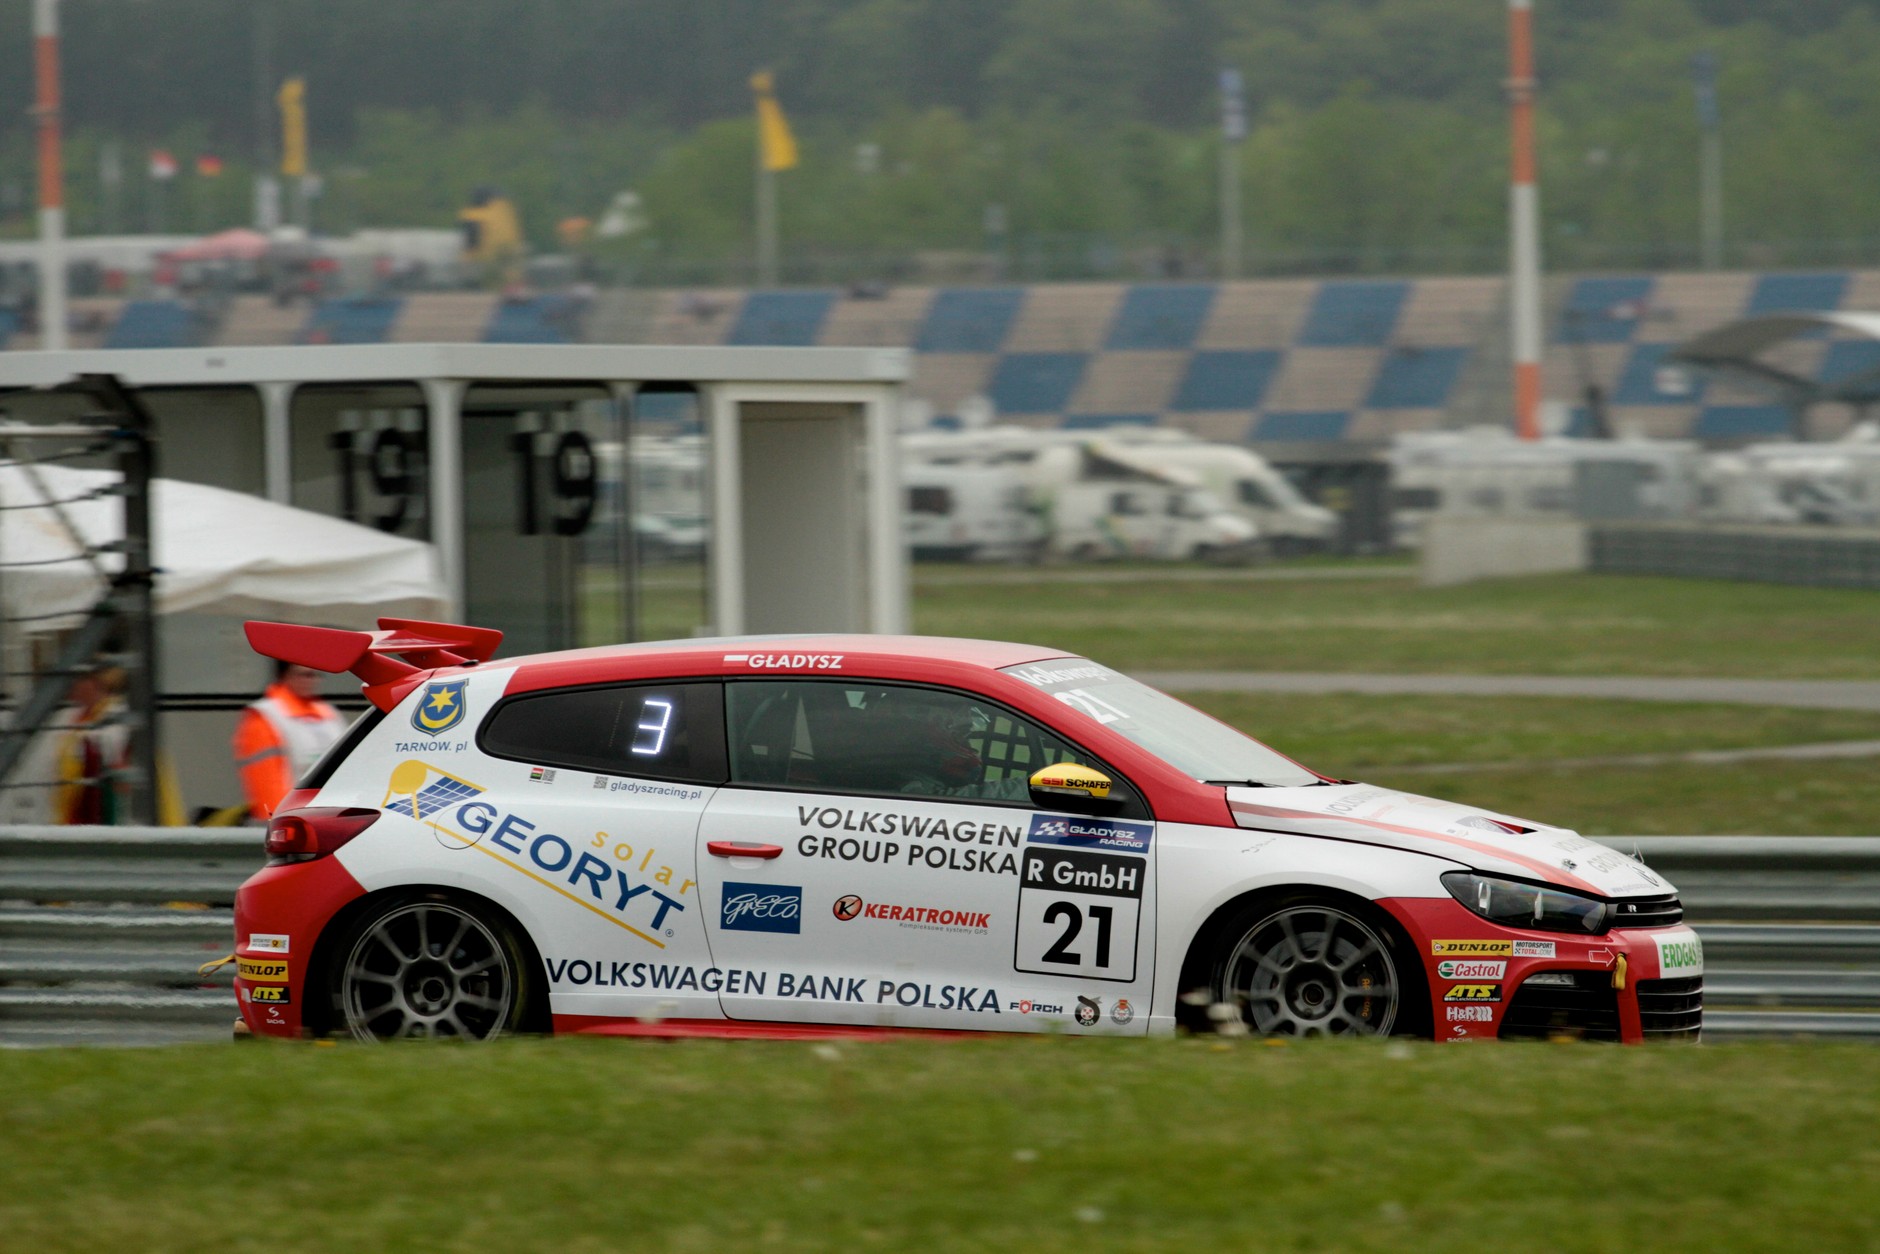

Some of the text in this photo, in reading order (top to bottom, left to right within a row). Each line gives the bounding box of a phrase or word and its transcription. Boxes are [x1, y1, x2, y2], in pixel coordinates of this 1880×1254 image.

[513, 431, 597, 536] 19
[748, 654, 844, 669] GŁADYSZ
[1053, 688, 1131, 724] 21
[632, 699, 672, 755] 3
[610, 780, 702, 800] gladyszracing.pl
[798, 805, 1023, 848] VOLKSWAGEN
[1069, 825, 1136, 840] GŁADYSZ
[1099, 838, 1144, 849] RACING
[591, 830, 697, 896] solar
[798, 835, 1018, 876] GROUP POLSKA
[456, 801, 685, 931] GEORYT
[1027, 858, 1137, 891] R GmbH
[864, 903, 991, 928] KERATRONIK
[945, 927, 972, 935] systemy
[973, 928, 988, 936] GPS
[1041, 900, 1113, 968] 21
[1446, 943, 1510, 952] DUNLOP
[1515, 941, 1553, 949] MOTORSPORT
[239, 963, 286, 976] DUNLOP
[1455, 963, 1500, 977] Castrol
[252, 987, 284, 1000] ATS
[546, 957, 1002, 1014] VOLKSWAGEN BANK POLSKA
[1445, 984, 1497, 998] ATS
[1446, 1006, 1479, 1021] H&R
